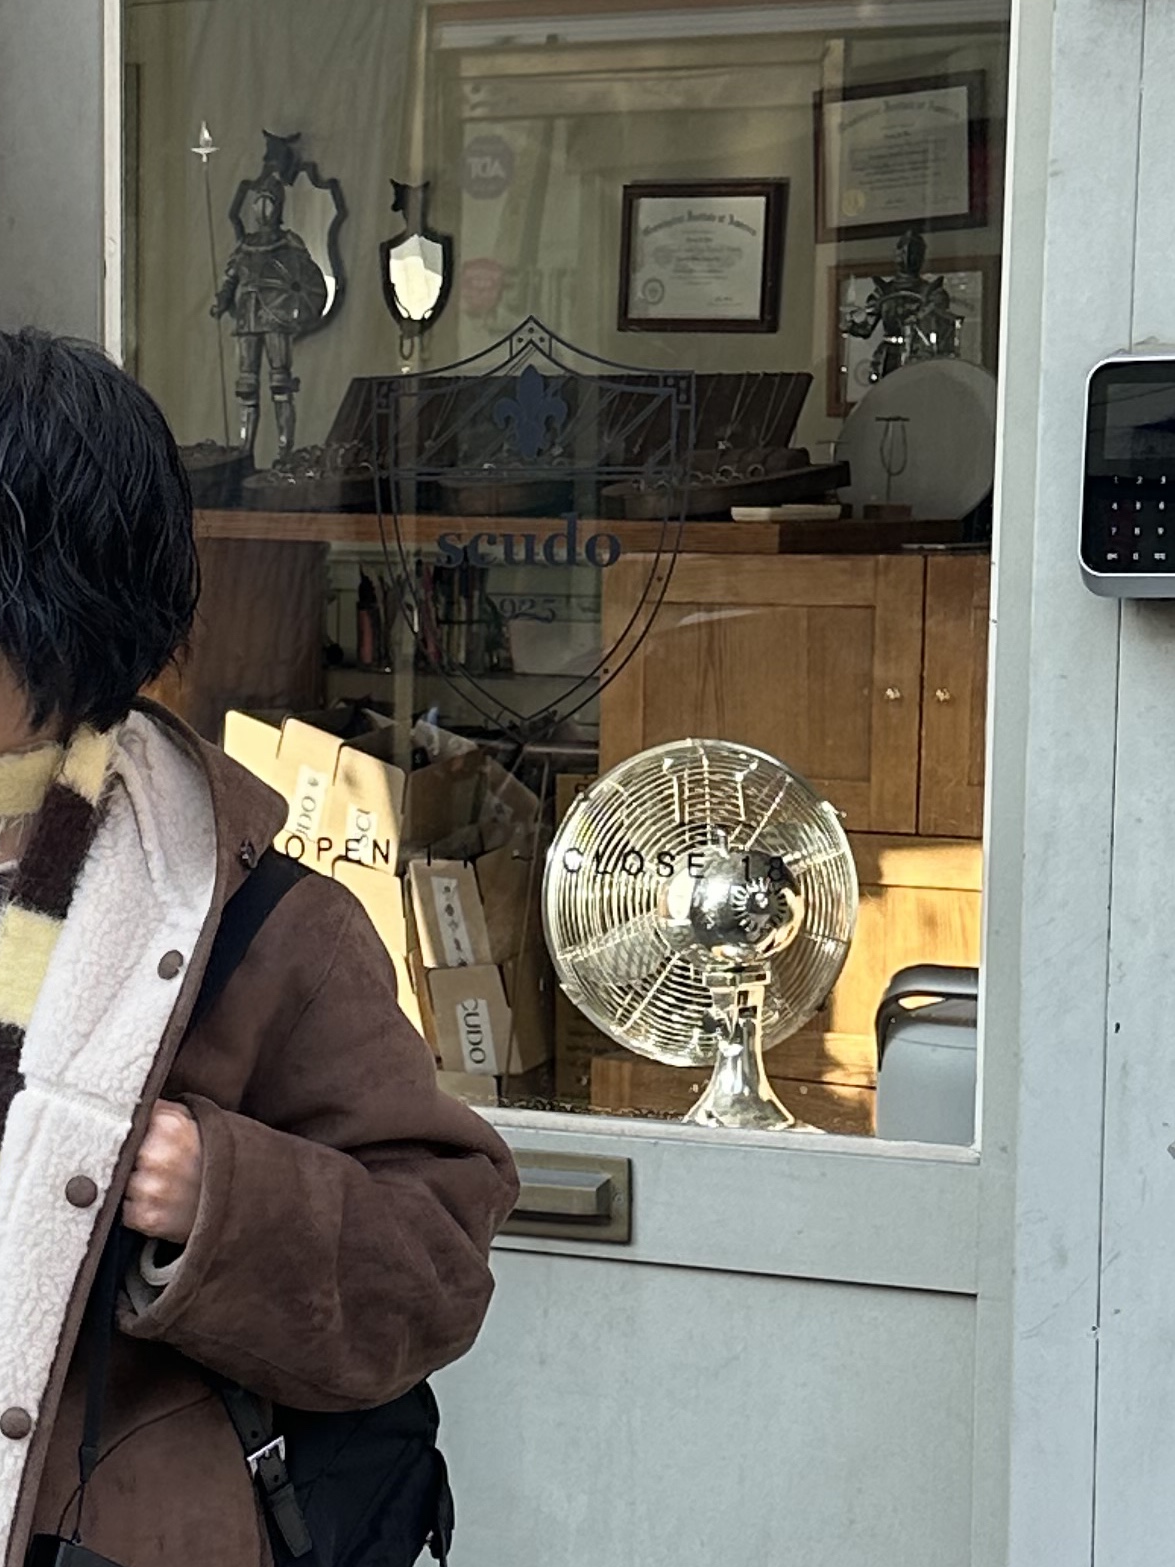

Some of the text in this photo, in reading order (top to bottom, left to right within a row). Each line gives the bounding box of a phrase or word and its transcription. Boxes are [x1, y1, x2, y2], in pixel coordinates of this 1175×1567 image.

[436, 512, 622, 568] scudo
[285, 835, 390, 865] OPEN
[563, 848, 705, 878] CLOSE
